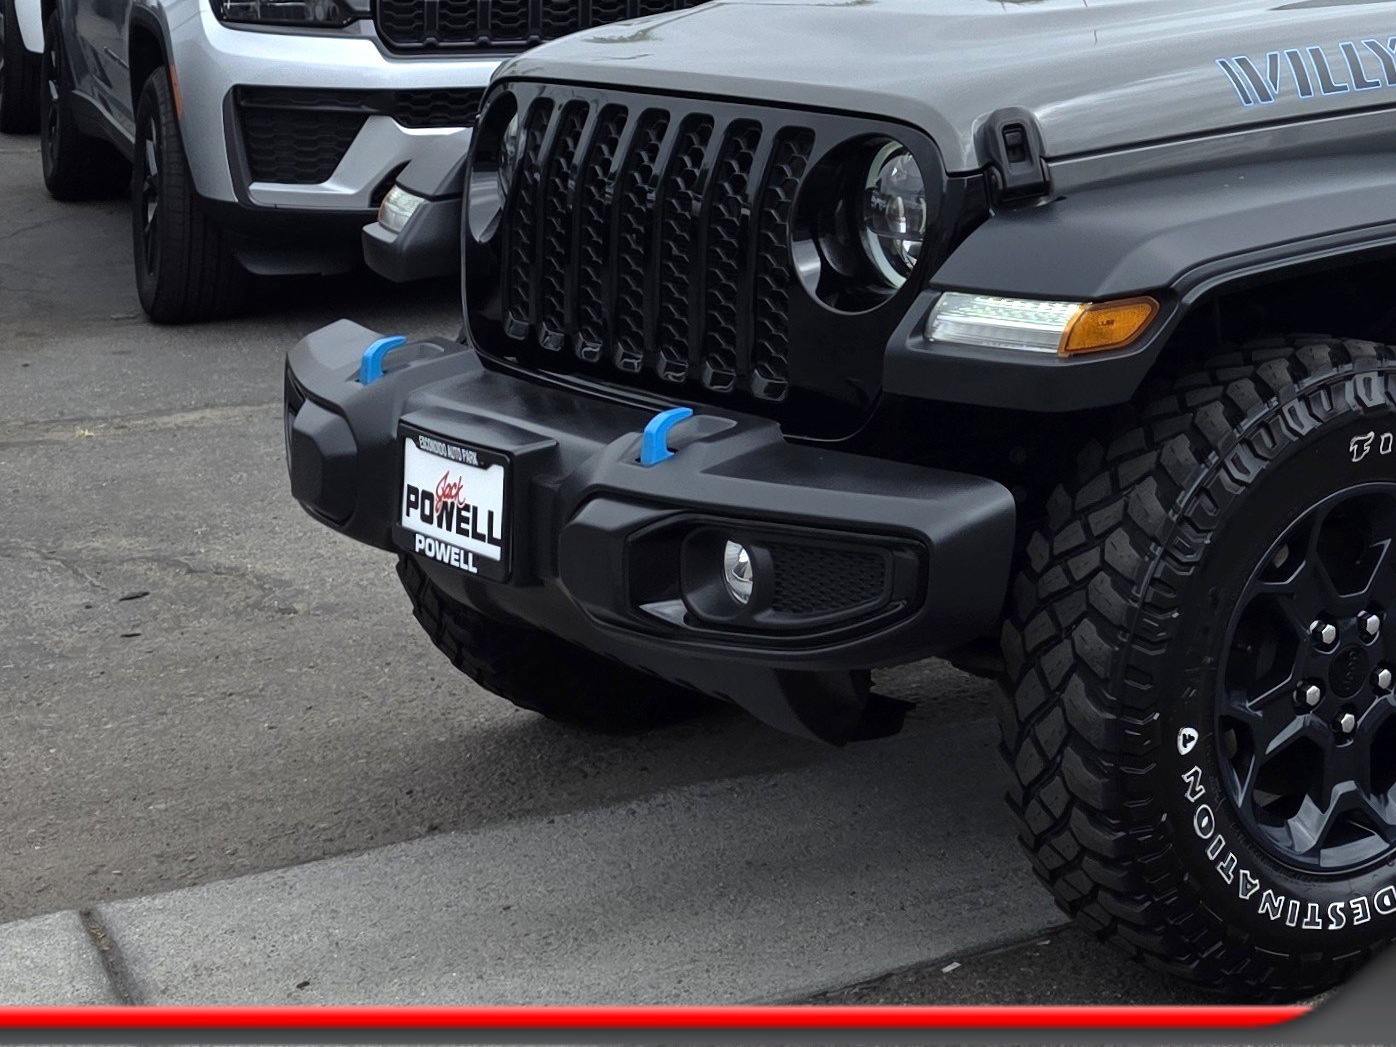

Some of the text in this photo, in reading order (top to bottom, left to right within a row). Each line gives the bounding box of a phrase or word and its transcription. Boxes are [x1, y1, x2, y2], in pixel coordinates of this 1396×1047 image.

[435, 470, 466, 514] Jack
[406, 483, 502, 547] POWELL
[414, 533, 478, 574] POWELL
